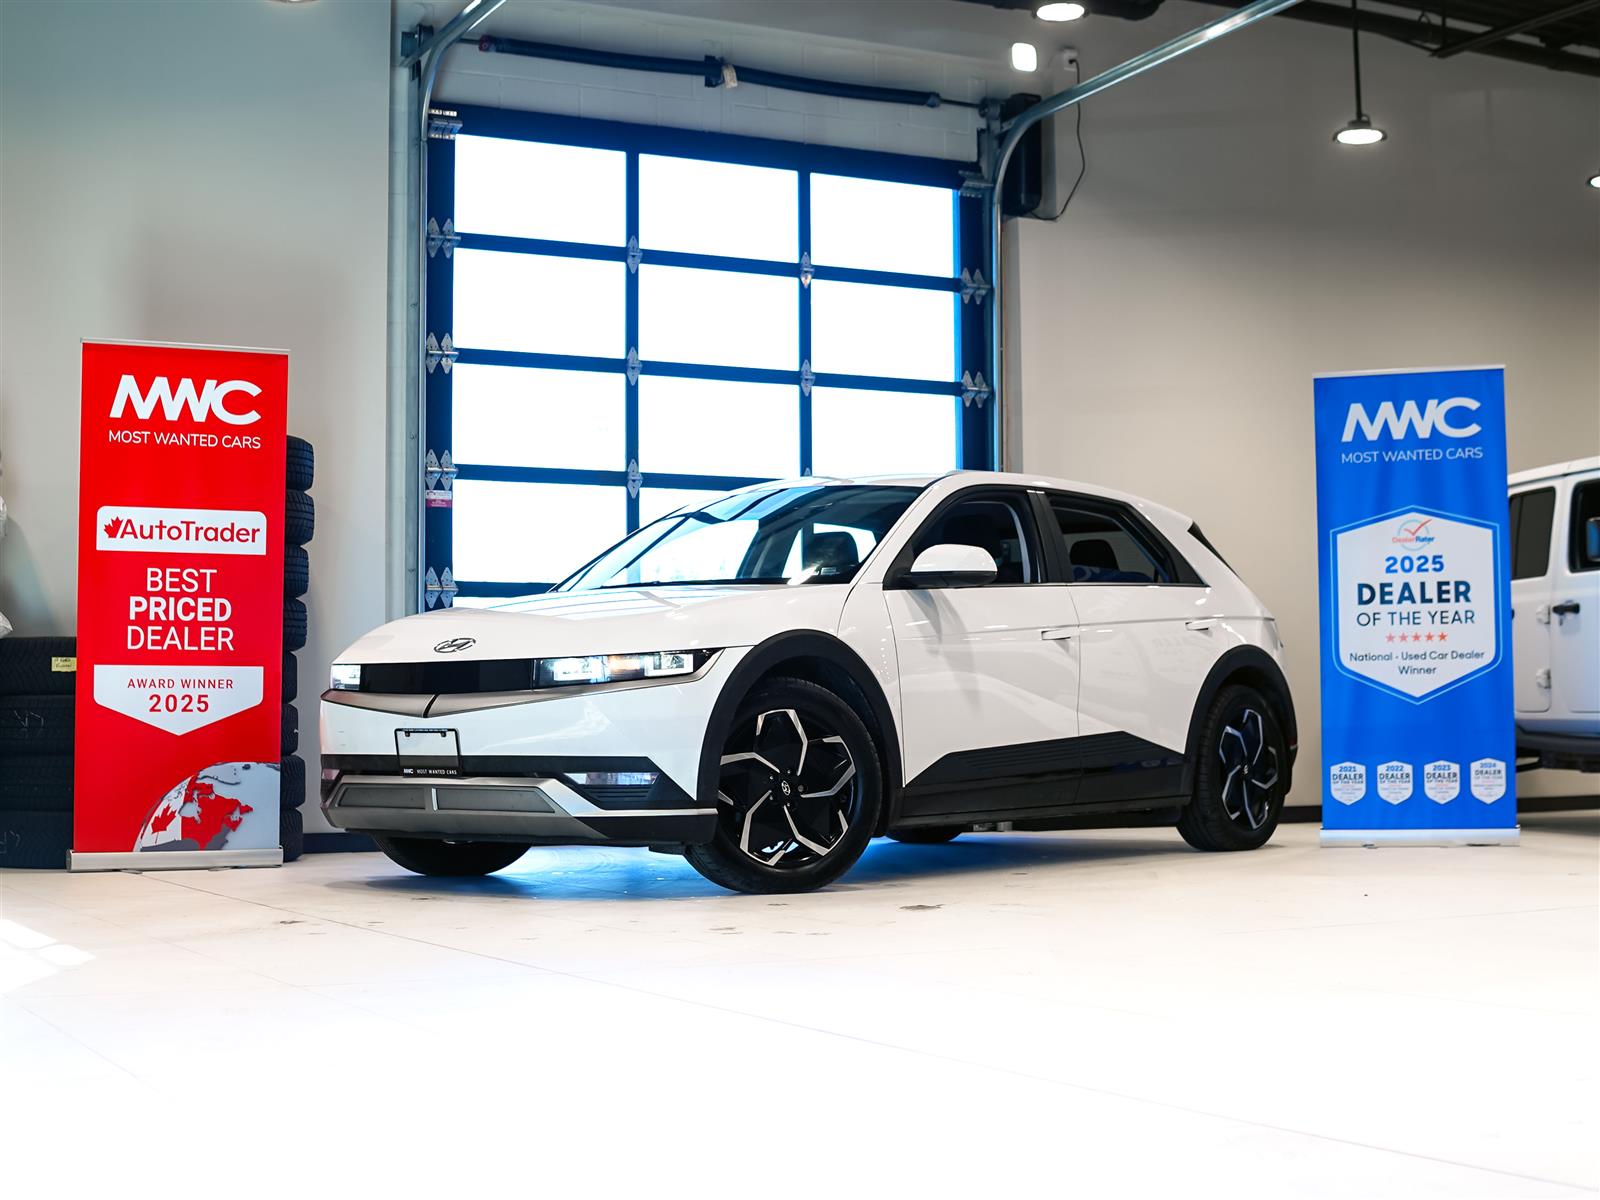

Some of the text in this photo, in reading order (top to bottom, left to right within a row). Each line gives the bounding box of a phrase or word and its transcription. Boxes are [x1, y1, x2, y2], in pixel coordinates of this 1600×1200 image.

[109, 374, 262, 425] MWC
[1341, 397, 1482, 442] MWC
[108, 430, 261, 449] MOST WANTED CARS
[1341, 447, 1483, 464] MOST WANTED CARS
[120, 518, 260, 543] AutoTrader
[1385, 554, 1444, 574] 2025
[146, 567, 217, 593] BEST
[1357, 580, 1471, 606] DEALER
[129, 596, 232, 622] PRICED
[1356, 609, 1475, 627] OF THE YEAR
[127, 625, 234, 651] DEALER
[1349, 651, 1393, 662] National
[1401, 651, 1427, 661] Used
[1429, 650, 1448, 661] Car
[1450, 650, 1485, 660] Dealer
[1398, 665, 1436, 675] Winner
[127, 678, 233, 690] AWARD WINNER
[148, 694, 209, 713] 2025
